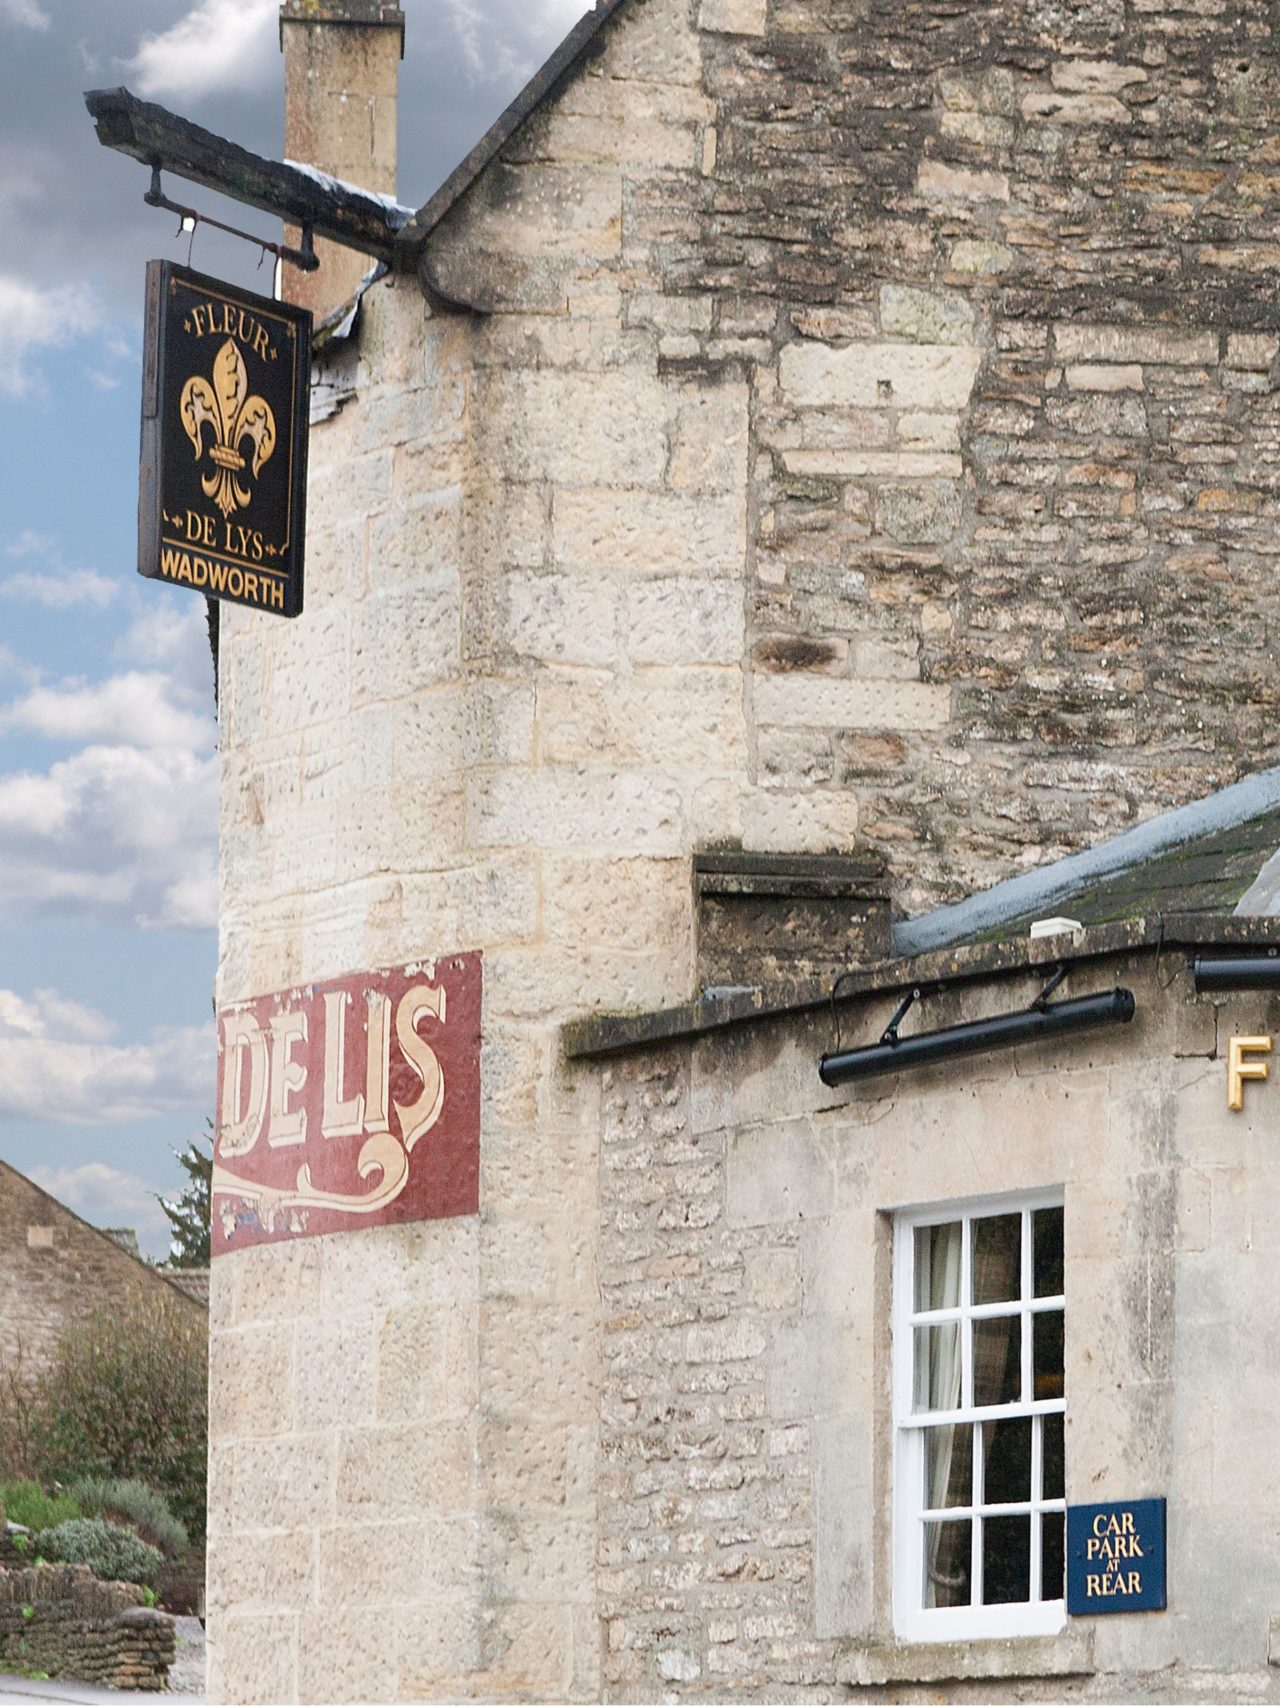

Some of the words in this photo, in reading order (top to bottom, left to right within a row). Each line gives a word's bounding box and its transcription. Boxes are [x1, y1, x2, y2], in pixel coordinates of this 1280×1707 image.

[190, 303, 271, 362] FLEUR
[187, 511, 216, 546] DE
[225, 523, 263, 560] LYS
[161, 548, 285, 609] WADWORTH
[1093, 1512, 1136, 1537] CAR
[1087, 1535, 1144, 1560] PARK
[1106, 1558, 1120, 1572] AT
[1086, 1572, 1142, 1597] REAR
